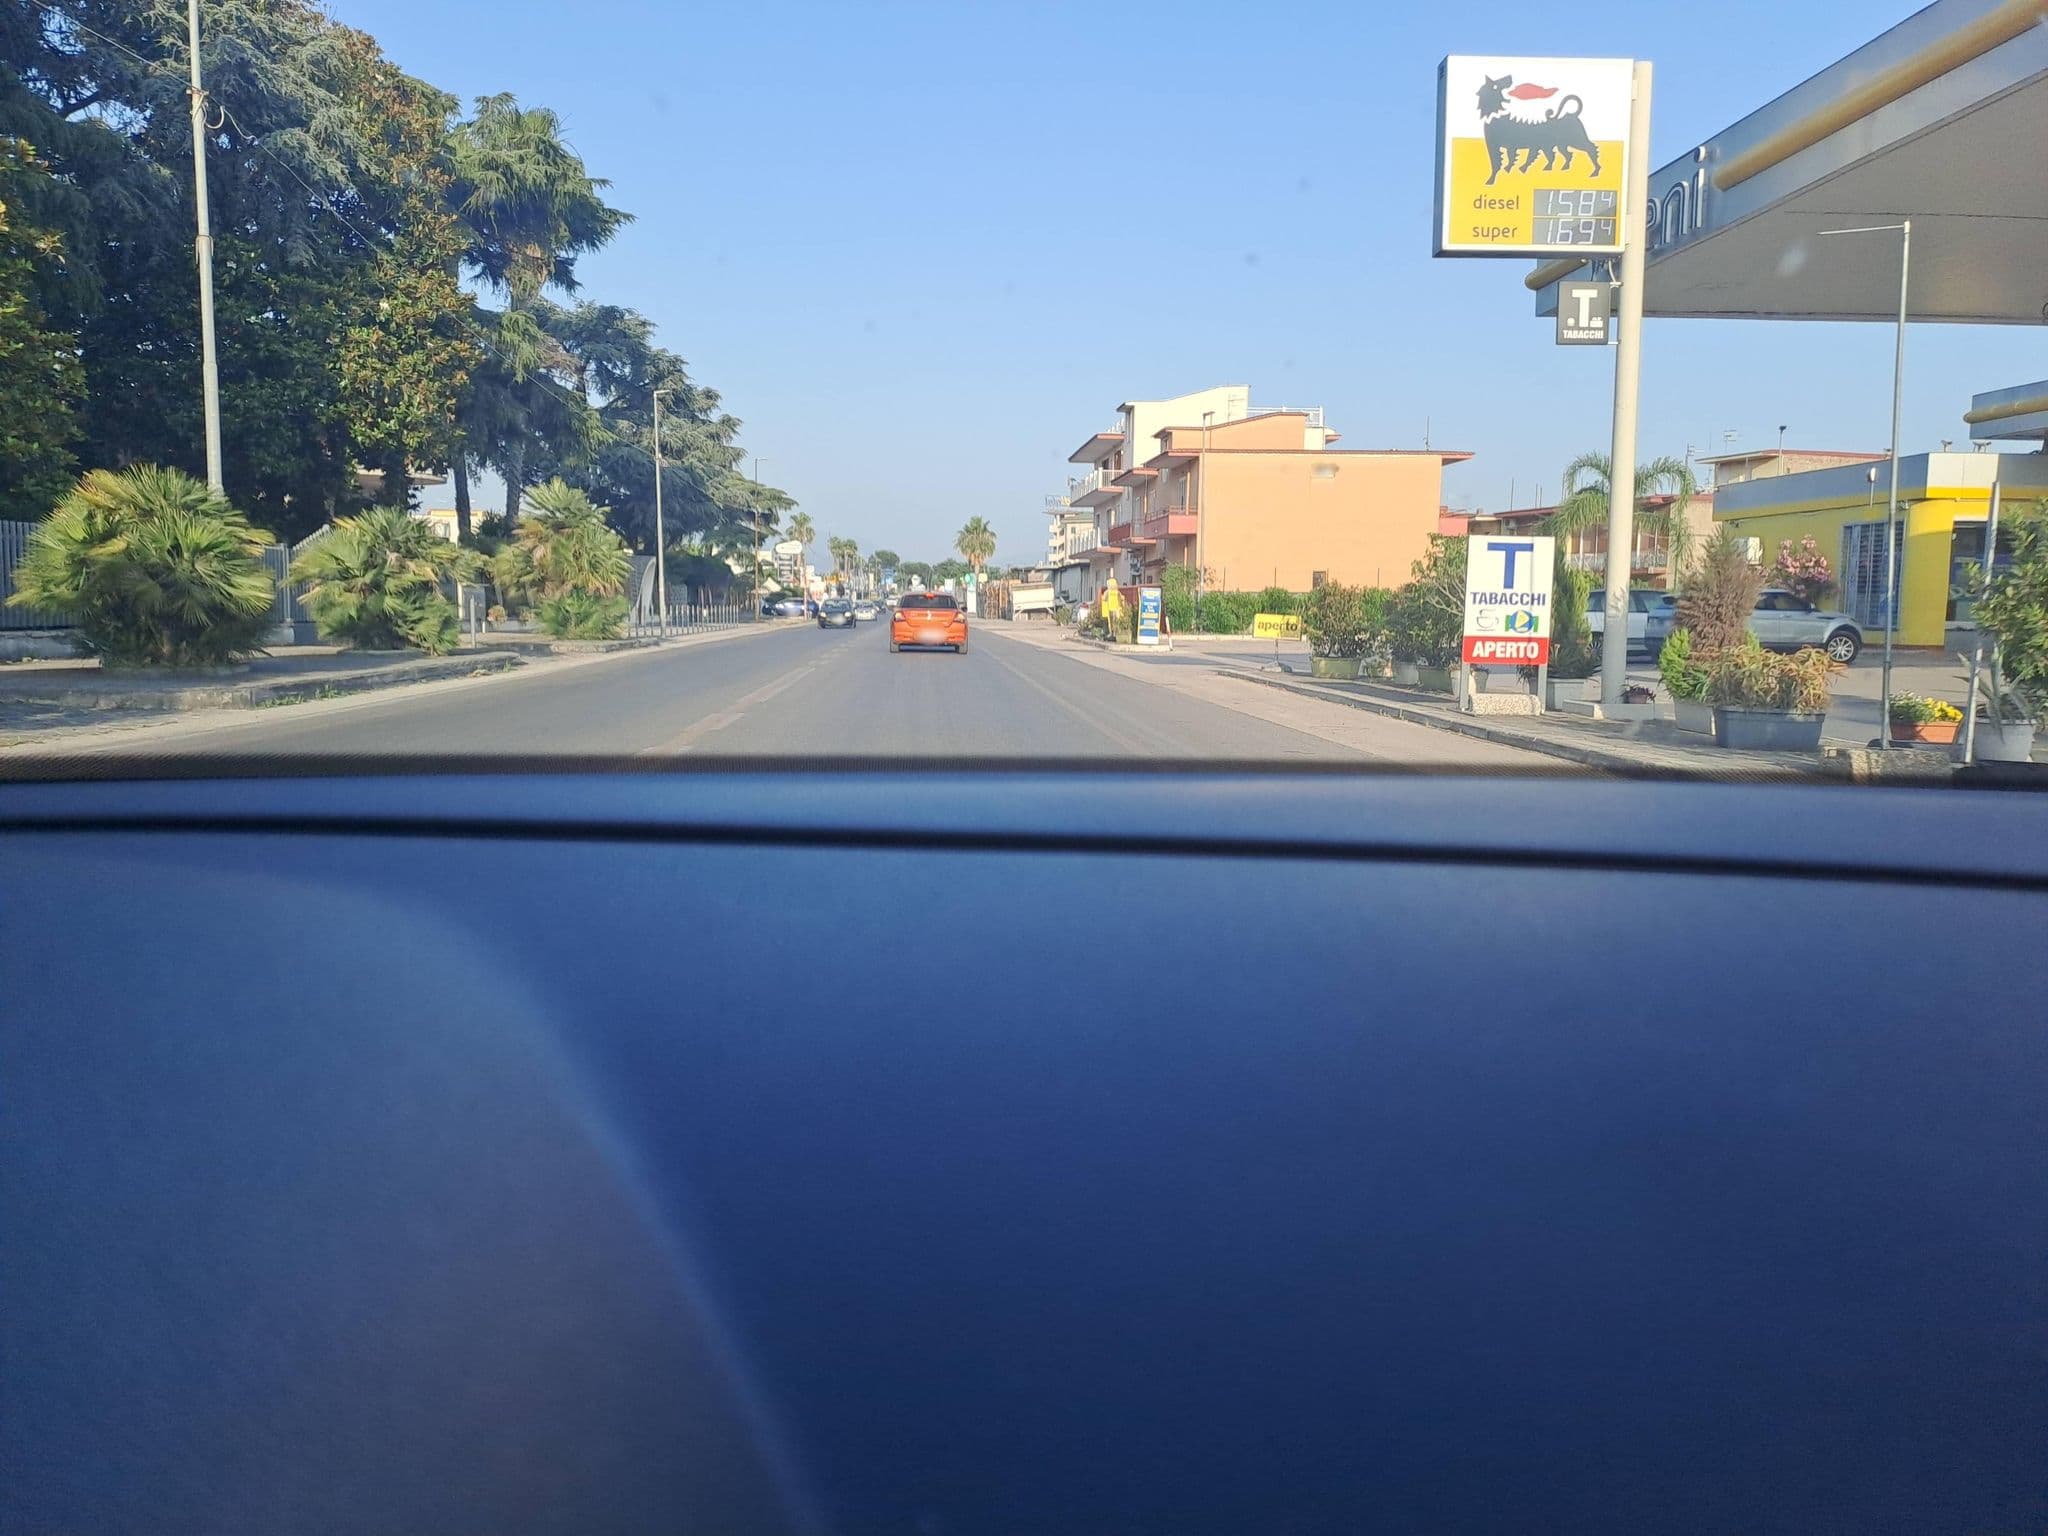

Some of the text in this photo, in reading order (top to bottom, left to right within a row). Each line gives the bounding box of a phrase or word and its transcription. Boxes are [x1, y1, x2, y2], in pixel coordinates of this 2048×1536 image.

[1473, 195, 1519, 210] diesel
[1472, 225, 1518, 241] super
[1563, 329, 1604, 339] TABACCHI
[1487, 542, 1534, 589] T
[1470, 592, 1546, 606] TABACCHI
[1257, 618, 1298, 632] aperto
[1472, 640, 1539, 659] APERTO
